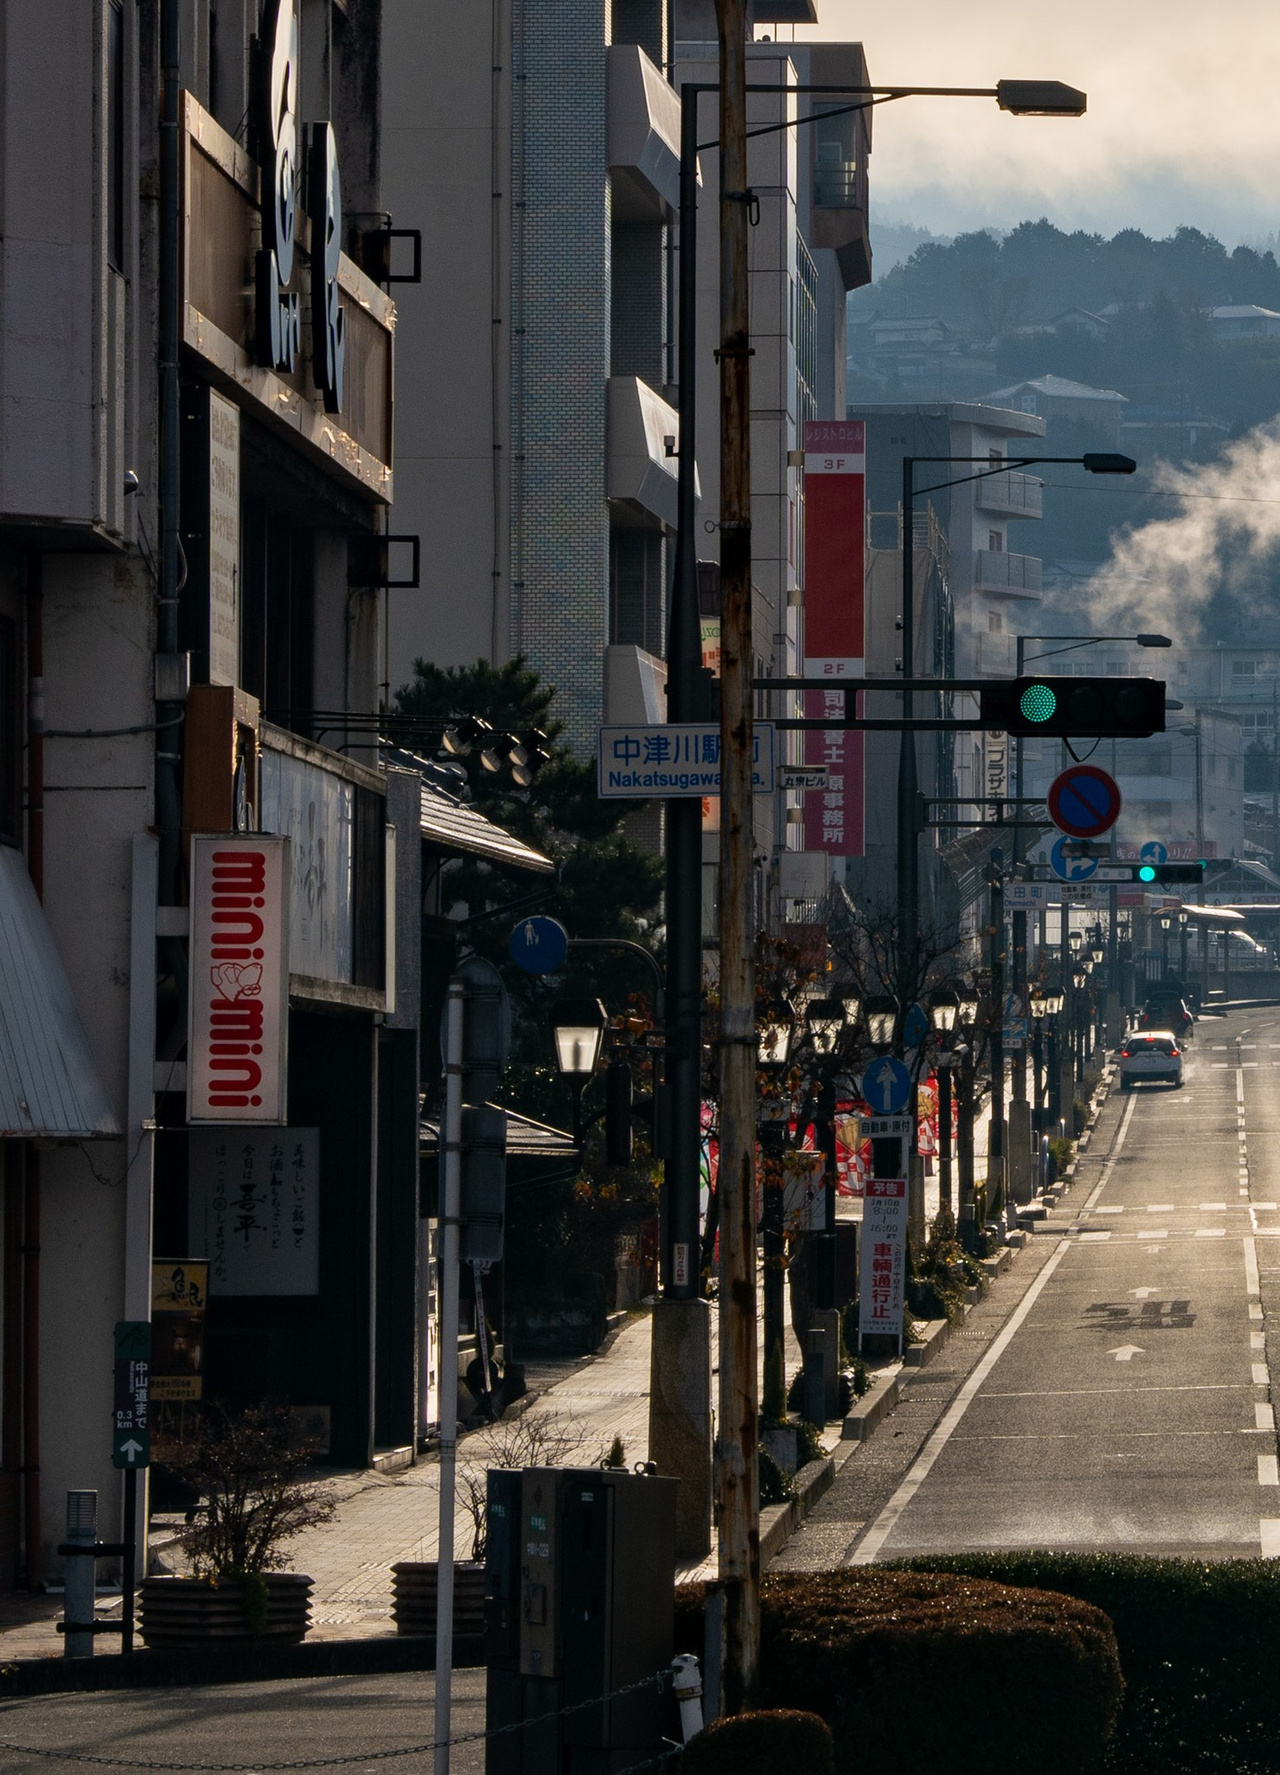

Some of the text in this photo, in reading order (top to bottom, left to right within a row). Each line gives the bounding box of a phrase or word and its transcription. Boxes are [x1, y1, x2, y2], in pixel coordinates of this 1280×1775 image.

[805, 426, 863, 442] レジストロビル
[824, 459, 845, 470] 3F
[824, 663, 845, 674] 2F
[613, 735, 759, 767] 中津川駅
[609, 772, 721, 789] Nakatsugawa
[208, 852, 266, 1108] mini mini
[873, 1183, 898, 1195] 予告
[135, 1360, 149, 1429] 中山道まで
[116, 1410, 133, 1420] 0.3
[116, 1419, 133, 1429] km
